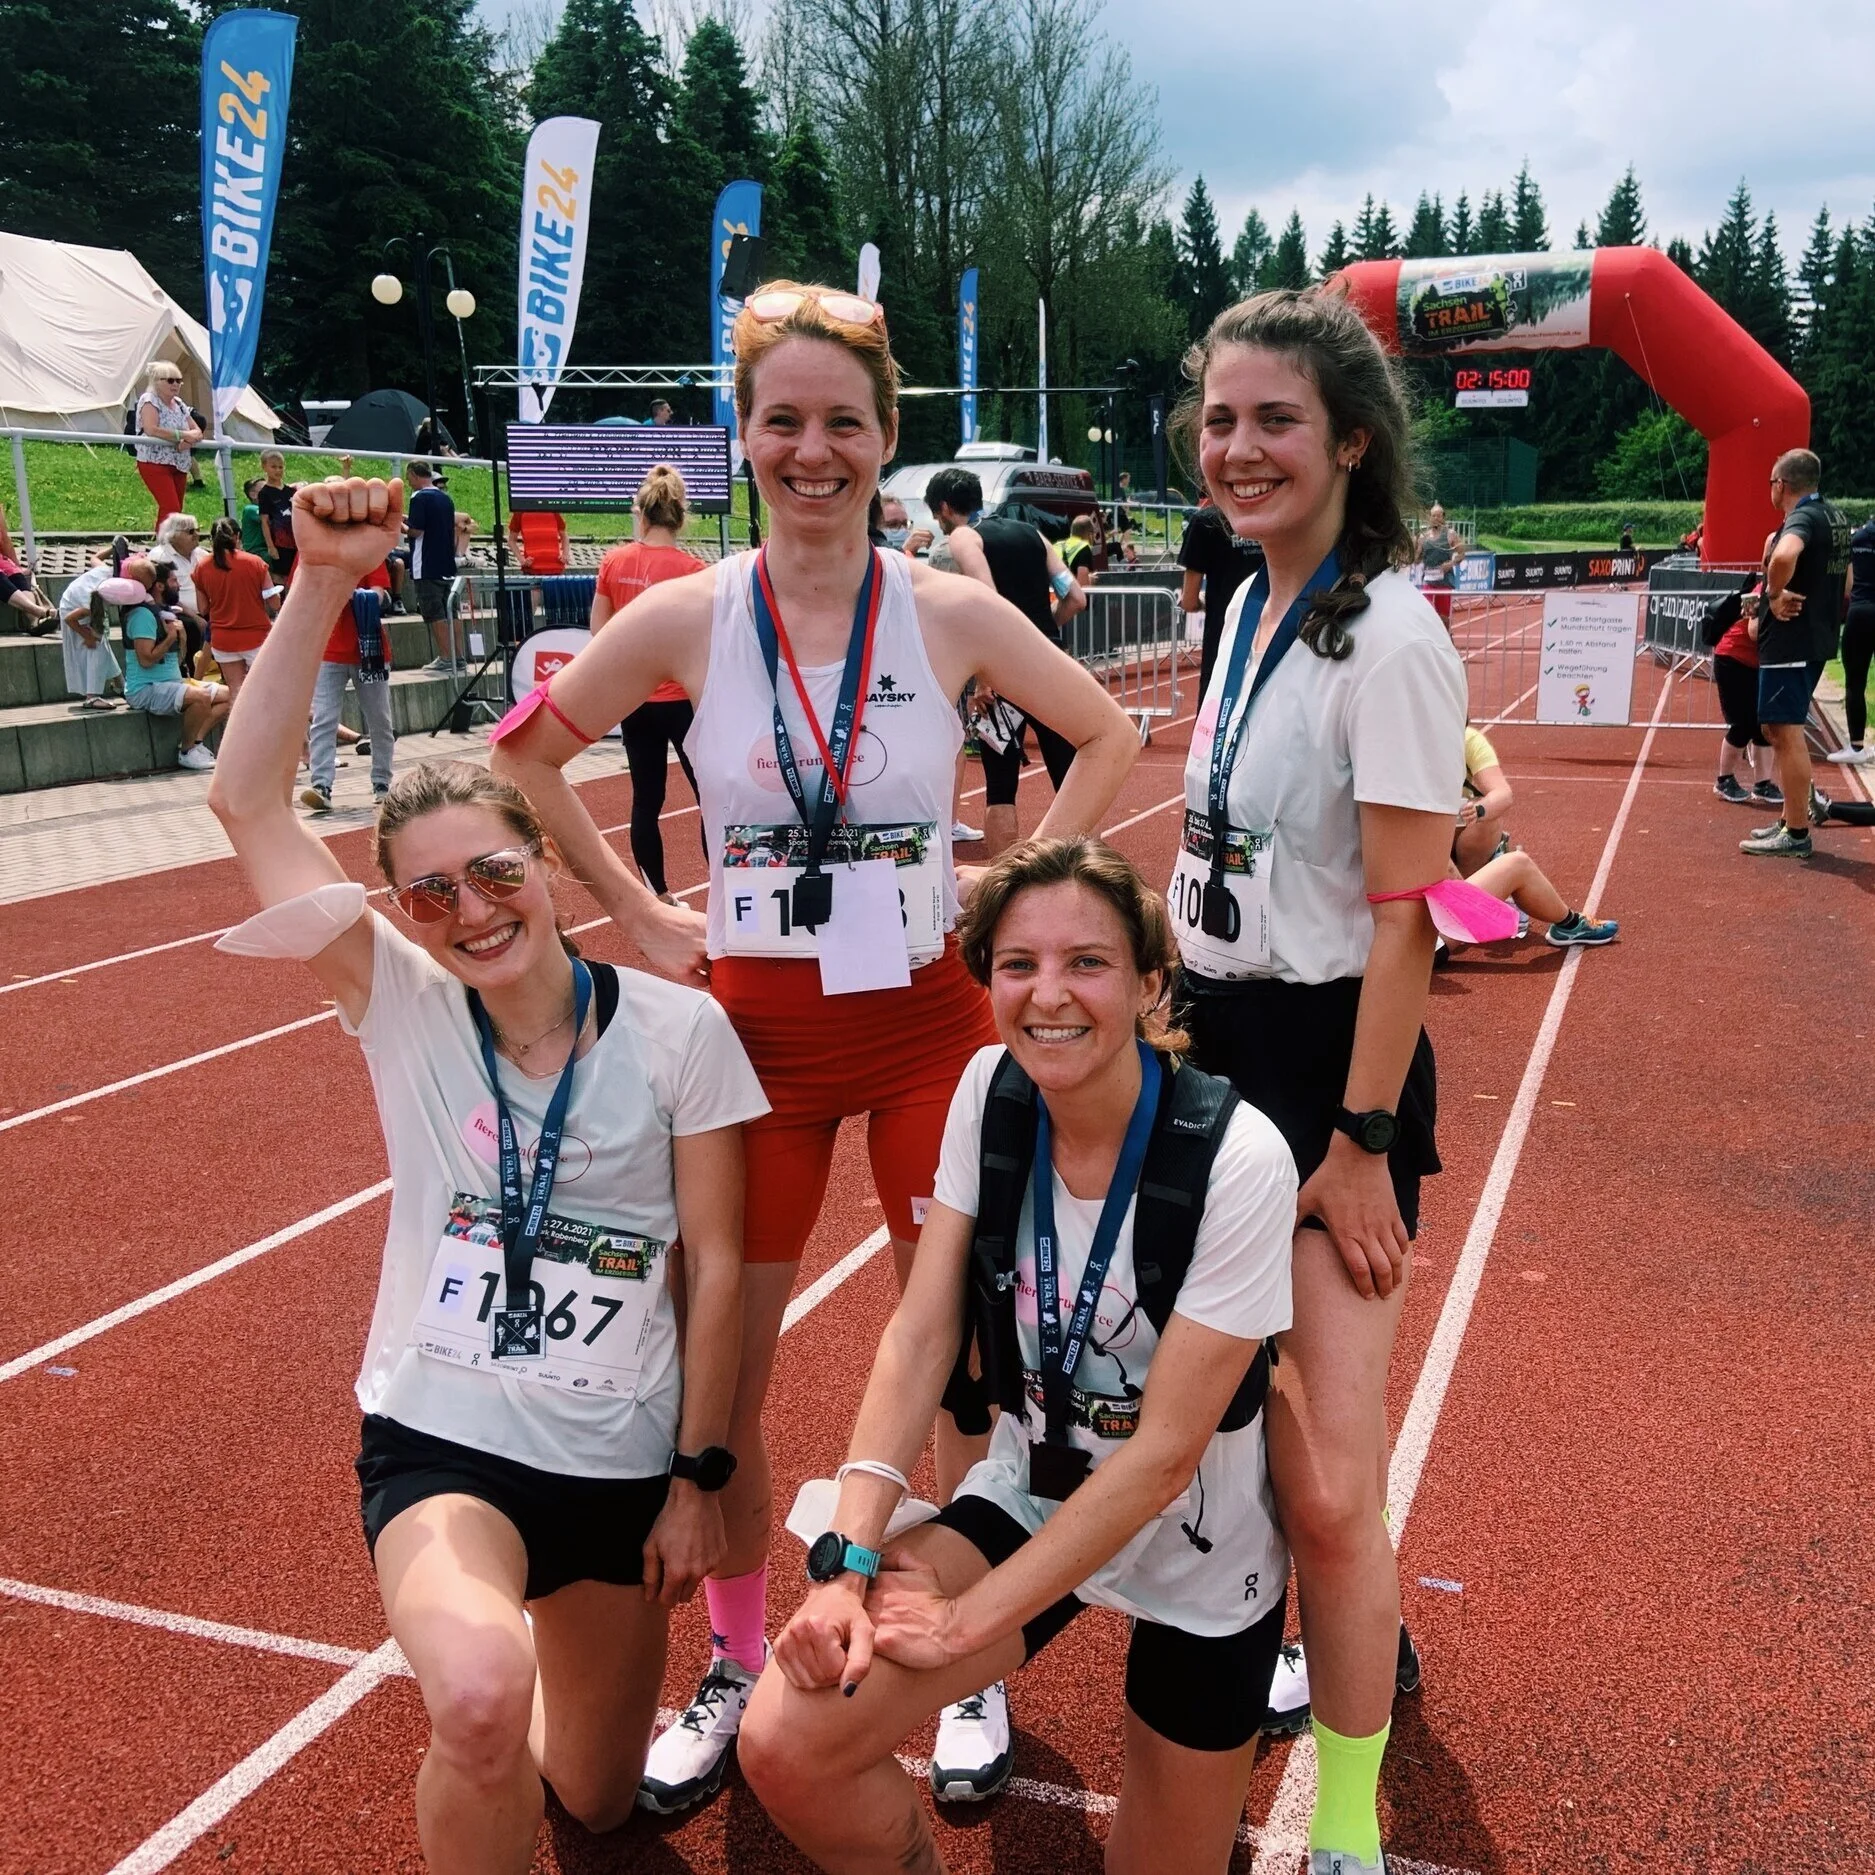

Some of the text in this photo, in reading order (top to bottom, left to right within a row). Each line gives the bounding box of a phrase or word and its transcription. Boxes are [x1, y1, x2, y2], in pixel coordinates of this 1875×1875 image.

[212, 60, 270, 268] BIKE24
[527, 158, 579, 326] BIKE24
[1423, 297, 1467, 311] Sachsen
[1425, 303, 1490, 329] TRAIL
[1456, 369, 1531, 389] 02:15:00
[1497, 569, 1516, 579] SUUNTO
[1525, 567, 1544, 577] SUUNTO
[1554, 566, 1573, 575] SUUNTO
[1588, 558, 1635, 577] SAXOPRINT
[1586, 616, 1623, 625] Startgasse
[1561, 624, 1605, 632] Mundschutz
[1558, 664, 1608, 673] Wegeführung
[735, 896, 752, 921] F
[1173, 1118, 1206, 1129] EVADICT
[550, 1220, 593, 1237] 27.6.2021
[551, 1230, 589, 1246] Rabenberg
[599, 1250, 628, 1258] Sachsen
[598, 1257, 638, 1271] TRAIL
[439, 1277, 464, 1303] F
[1043, 1277, 1052, 1308] TRAIL
[1075, 1307, 1088, 1335] TRAIL
[434, 1345, 461, 1360] BIKE24
[538, 1372, 561, 1381] SUUNTO
[1101, 1420, 1136, 1431] TRA
